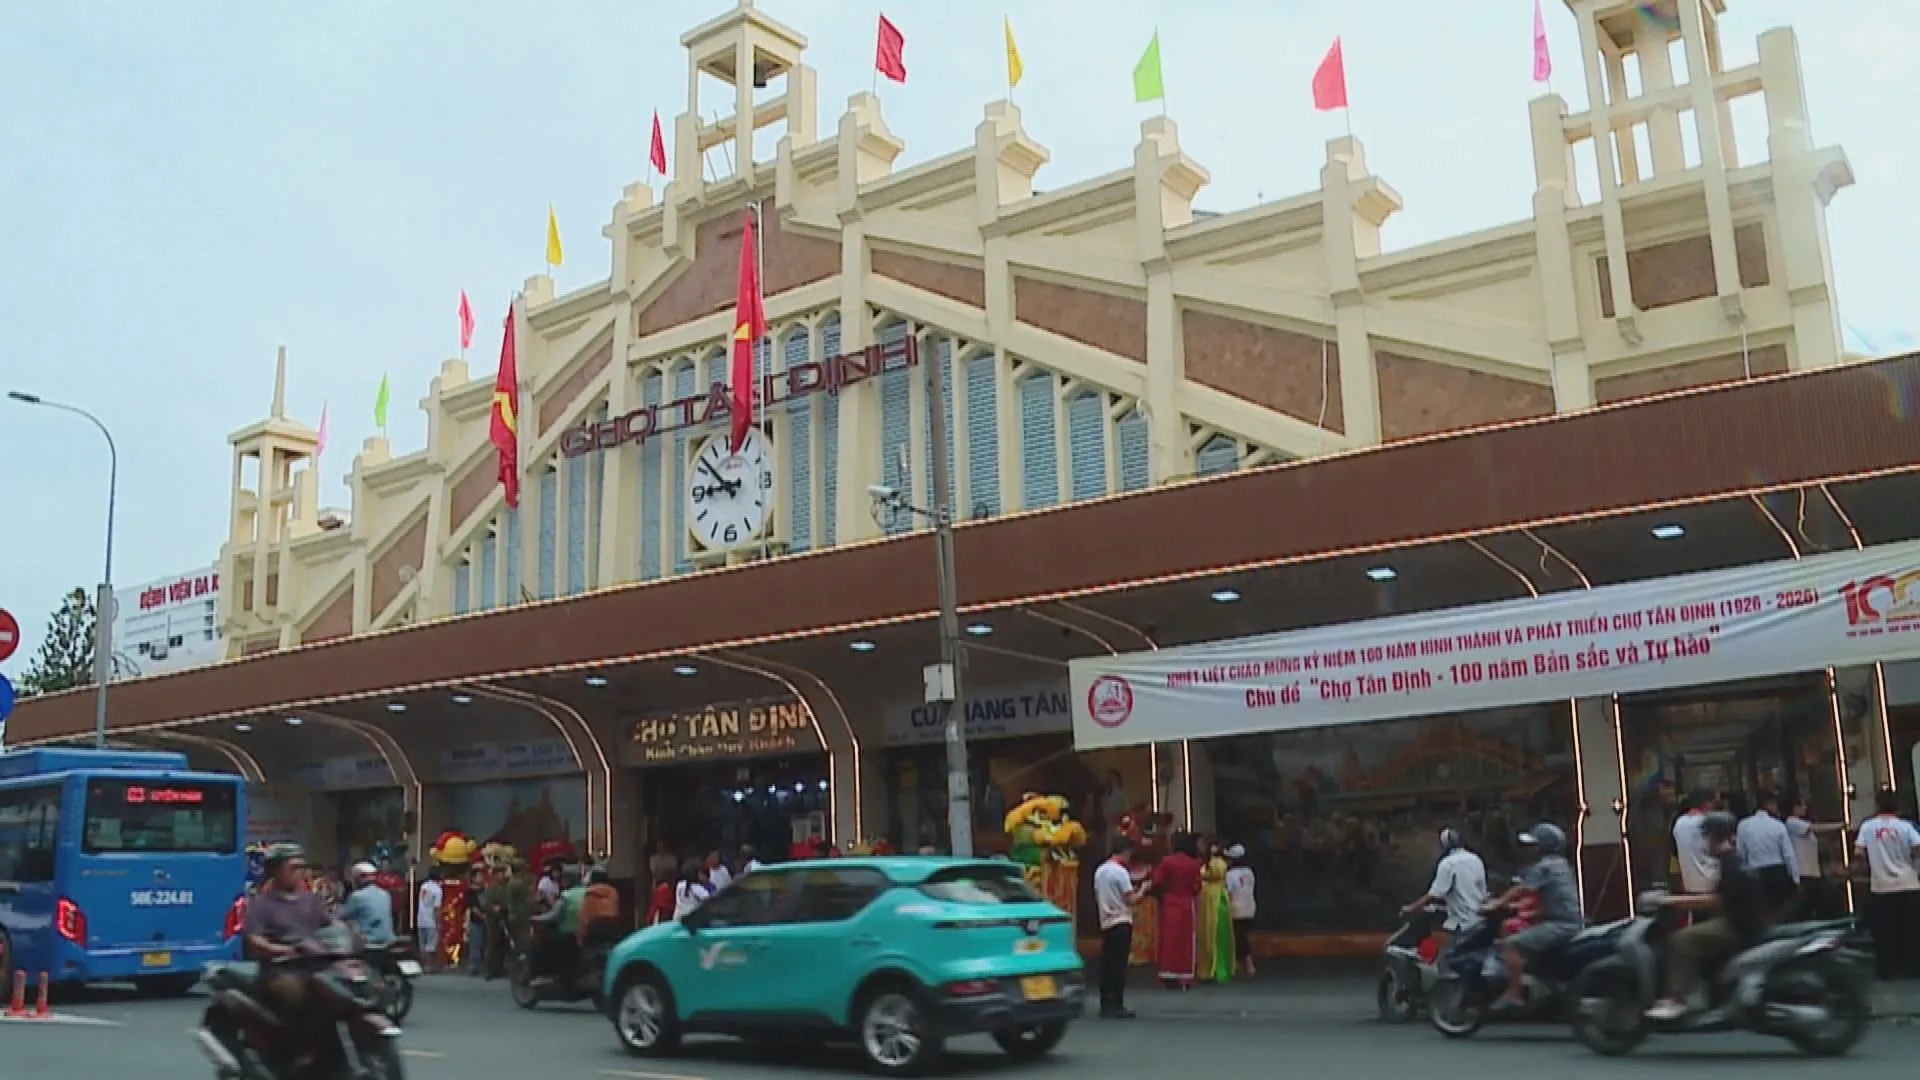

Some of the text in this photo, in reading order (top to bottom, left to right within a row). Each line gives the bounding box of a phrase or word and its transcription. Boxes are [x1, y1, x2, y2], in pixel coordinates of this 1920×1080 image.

[561, 404, 657, 458] CHỢ
[788, 335, 918, 397] ĐỊNH
[1245, 684, 1276, 709] Chủ
[1356, 673, 1388, 696] Tân
[1392, 667, 1432, 696] Định
[1450, 661, 1483, 686] 100
[1488, 657, 1528, 681] năm
[1533, 649, 1570, 675] Bản
[1575, 641, 1609, 670] sắc
[1616, 640, 1639, 665] và
[1264, 656, 1300, 676] MỪNG
[1323, 648, 1356, 669] NIỆM
[1360, 646, 1383, 665] 100
[1386, 640, 1416, 660] NĂM
[1420, 637, 1453, 655] HÌNH
[1456, 628, 1501, 651] THÀNH
[1505, 623, 1524, 645] VÀ
[1527, 620, 1562, 643] PHÁT
[1613, 610, 1642, 632] CHỢ
[1647, 605, 1676, 626] TÂN
[685, 703, 740, 738] TÂN
